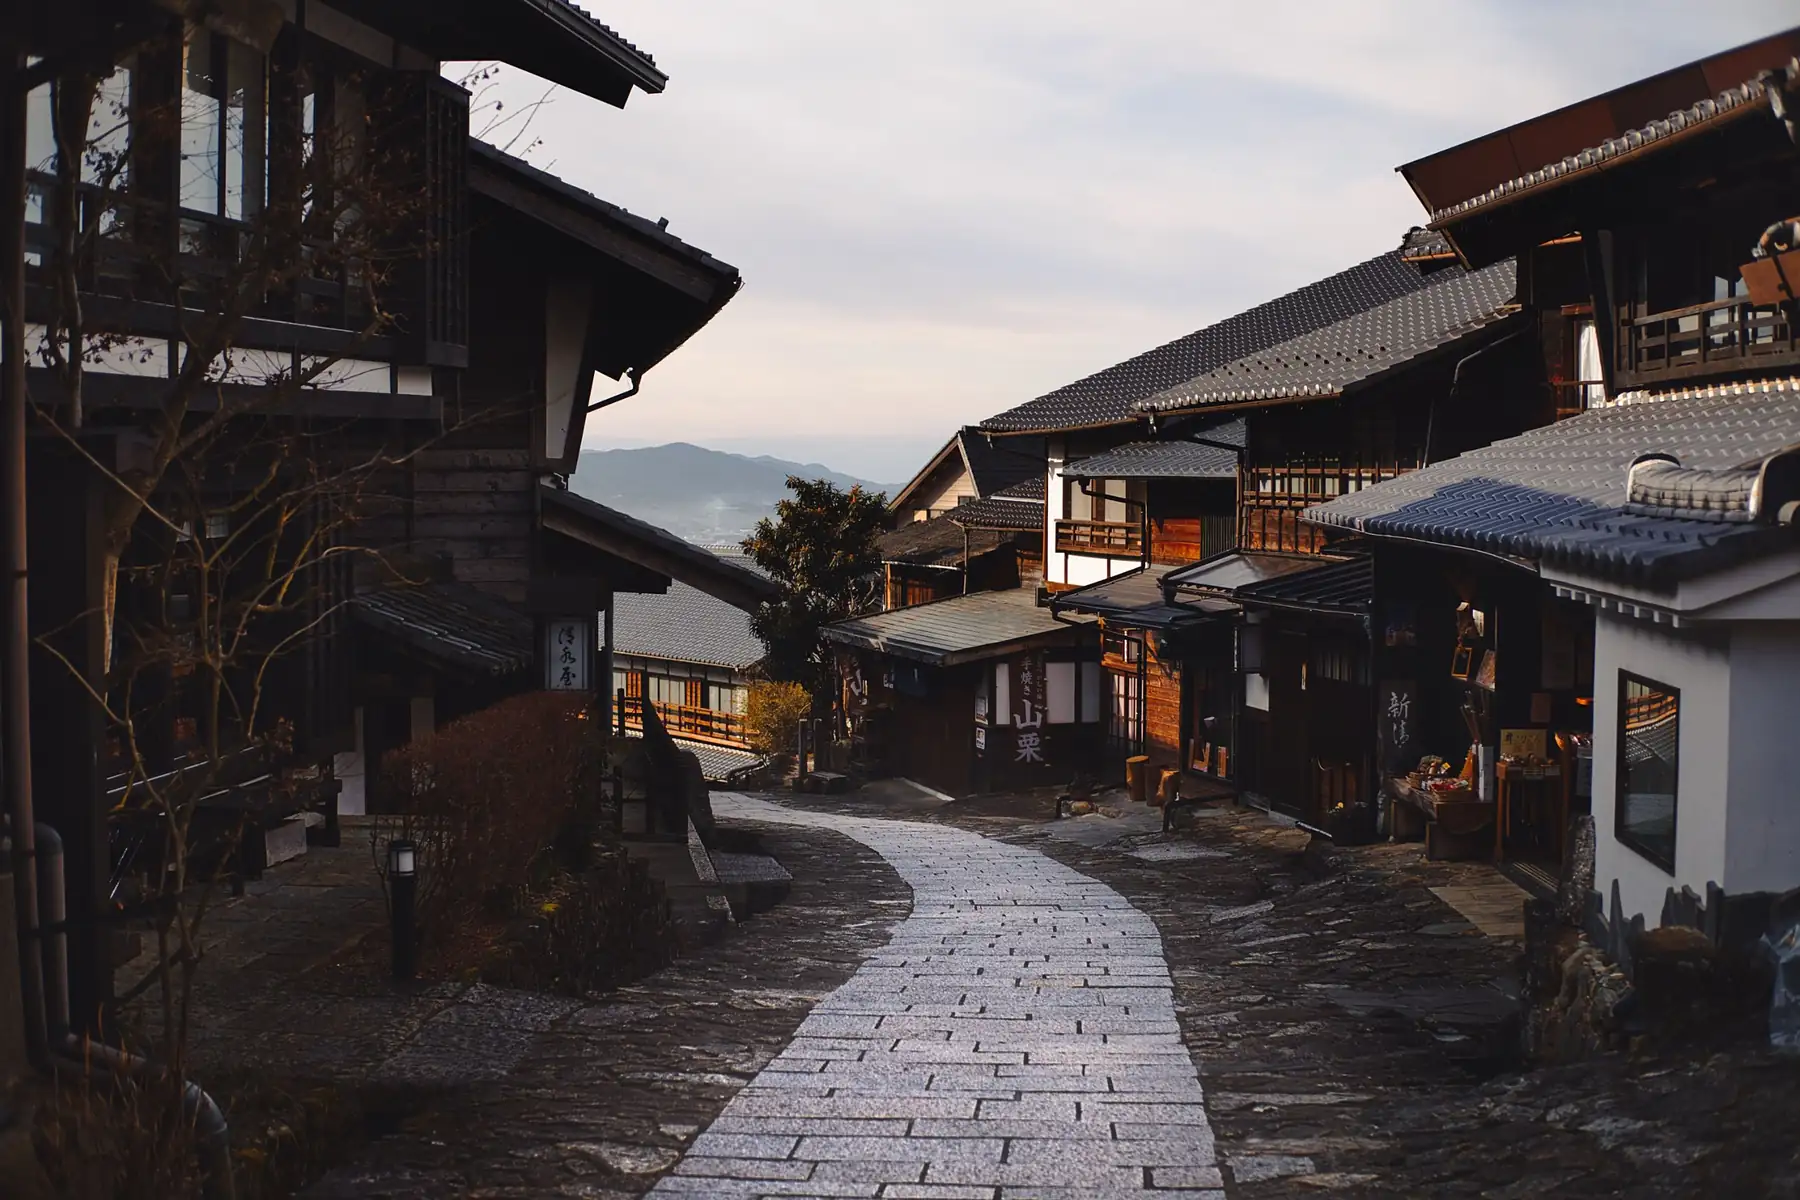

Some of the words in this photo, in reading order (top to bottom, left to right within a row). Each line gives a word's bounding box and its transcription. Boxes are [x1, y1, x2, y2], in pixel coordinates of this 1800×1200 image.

[1020, 656, 1032, 696] 手焼き
[1013, 699, 1043, 762] 山栗
